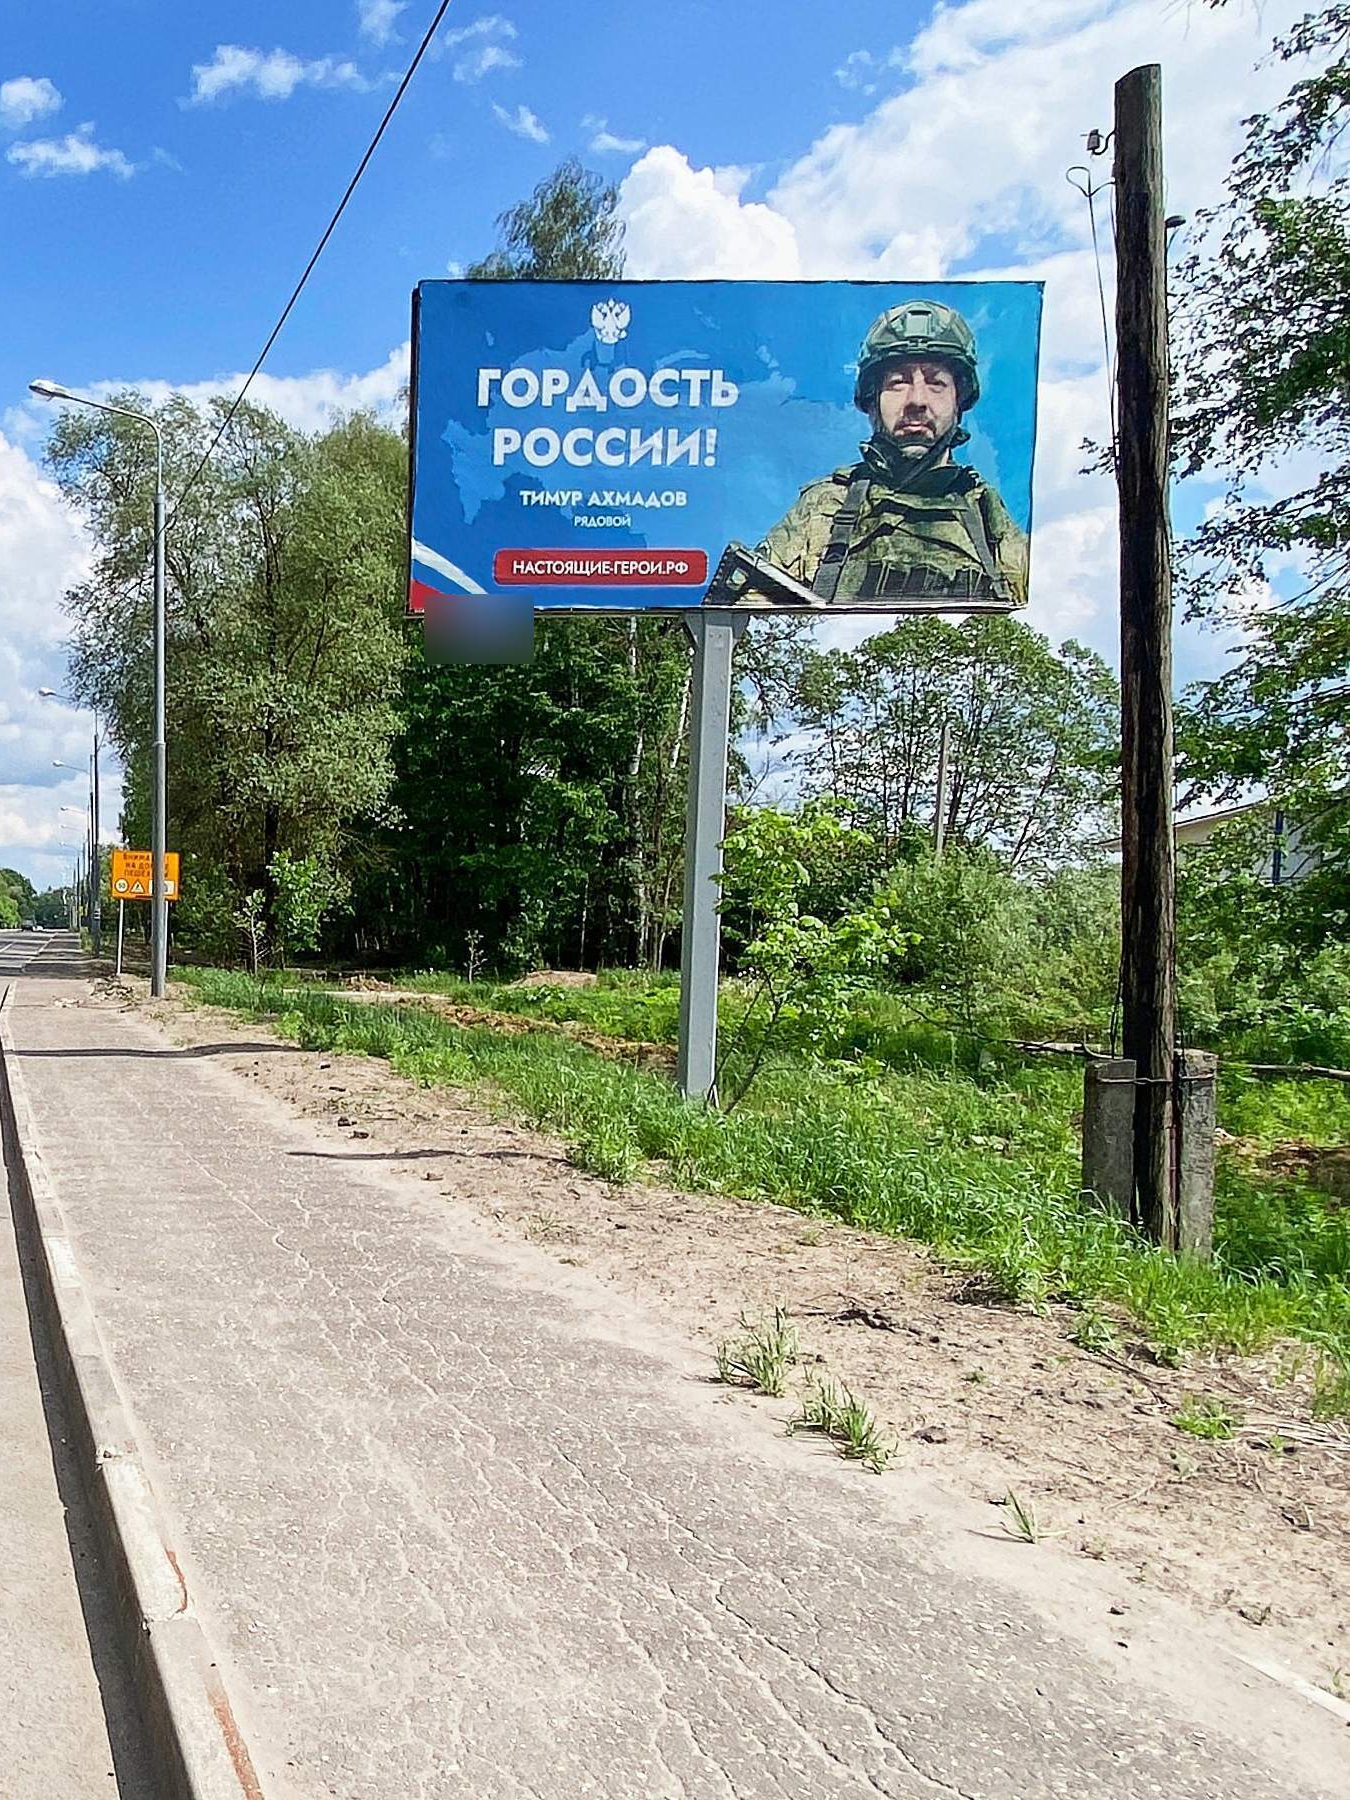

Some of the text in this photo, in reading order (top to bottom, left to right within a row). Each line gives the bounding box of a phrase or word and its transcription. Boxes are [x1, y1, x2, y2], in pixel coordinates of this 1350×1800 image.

[477, 367, 740, 413] ГОРДОСТЬ
[492, 426, 719, 467] РОССИИ!
[519, 490, 688, 508] ТИМУР АХМАДОВ
[574, 513, 631, 528] РЯДОВОЙ
[512, 560, 689, 577] НАСТОЯЩИЕ-ГЕРОИ.РФ
